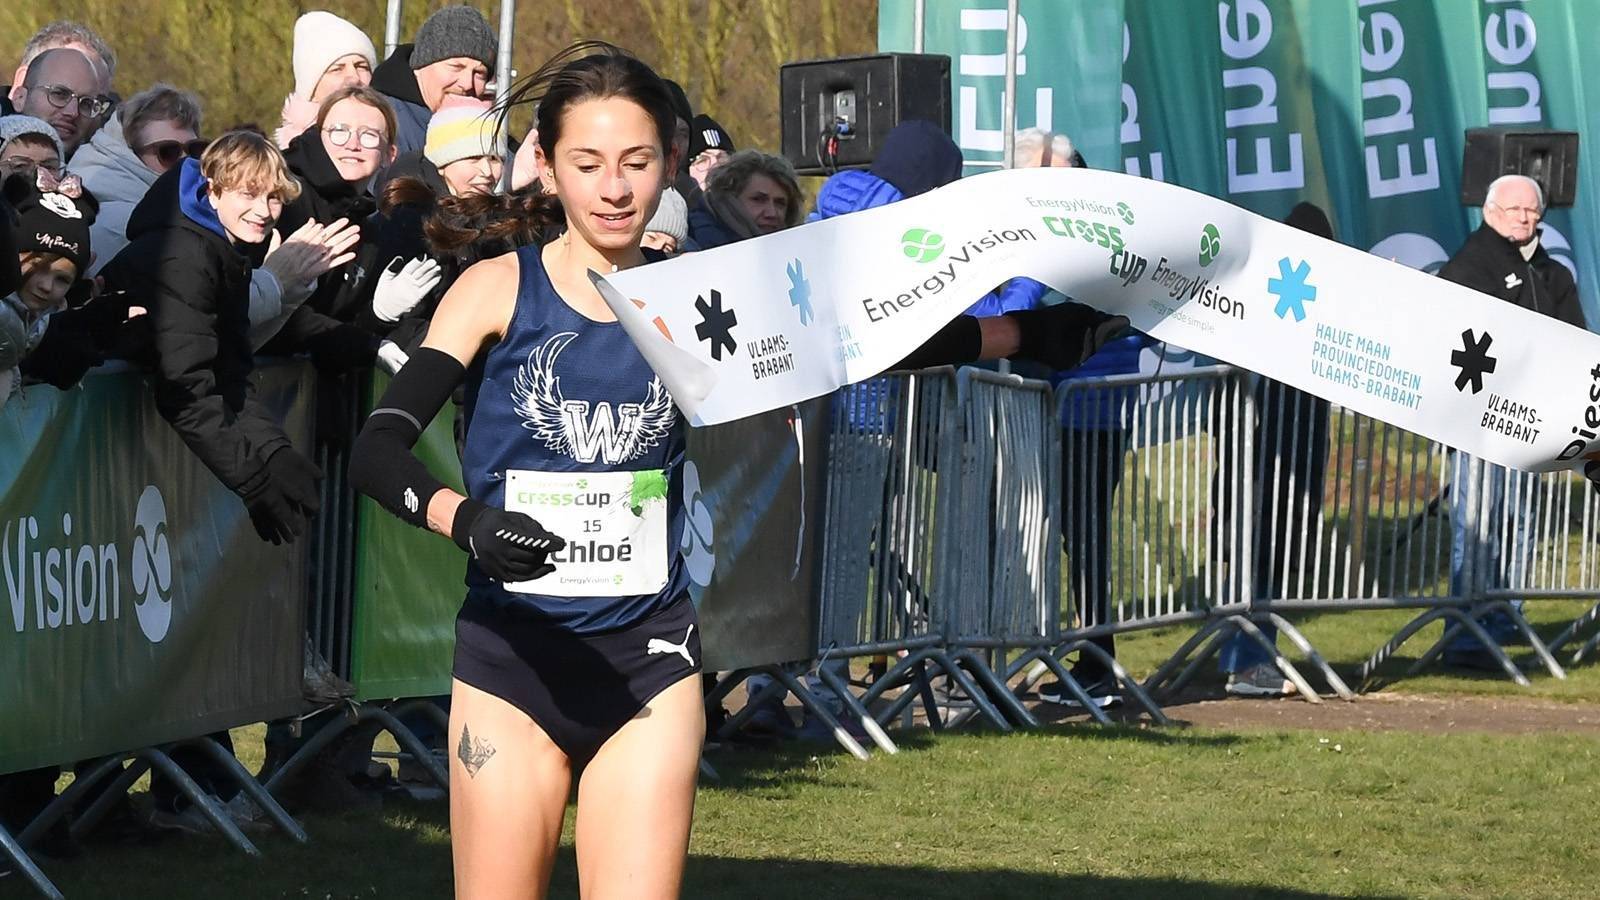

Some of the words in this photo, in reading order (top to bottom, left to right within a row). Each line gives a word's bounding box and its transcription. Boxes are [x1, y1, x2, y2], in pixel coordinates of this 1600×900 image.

[1484, 0, 1542, 124] ne
[1358, 0, 1440, 199] Ene
[1025, 197, 1116, 217] EnergyVision
[862, 227, 1037, 323] EnergyVision
[1109, 249, 1148, 288] cup
[1151, 257, 1245, 320] EnergyVision
[747, 334, 789, 358] VLAAMS-
[1316, 322, 1354, 348] HALVE
[1356, 336, 1391, 360] MAAN
[752, 353, 795, 379] BRABANT
[1311, 359, 1422, 410] VLAAMS-BRABANT
[1312, 341, 1421, 390] PROVINCIEDOMEIN
[1481, 412, 1540, 445] BRABANT
[1488, 393, 1542, 424] VLAAMS-
[564, 400, 640, 465] W
[583, 519, 602, 533] 15
[2, 512, 120, 632] Vision
